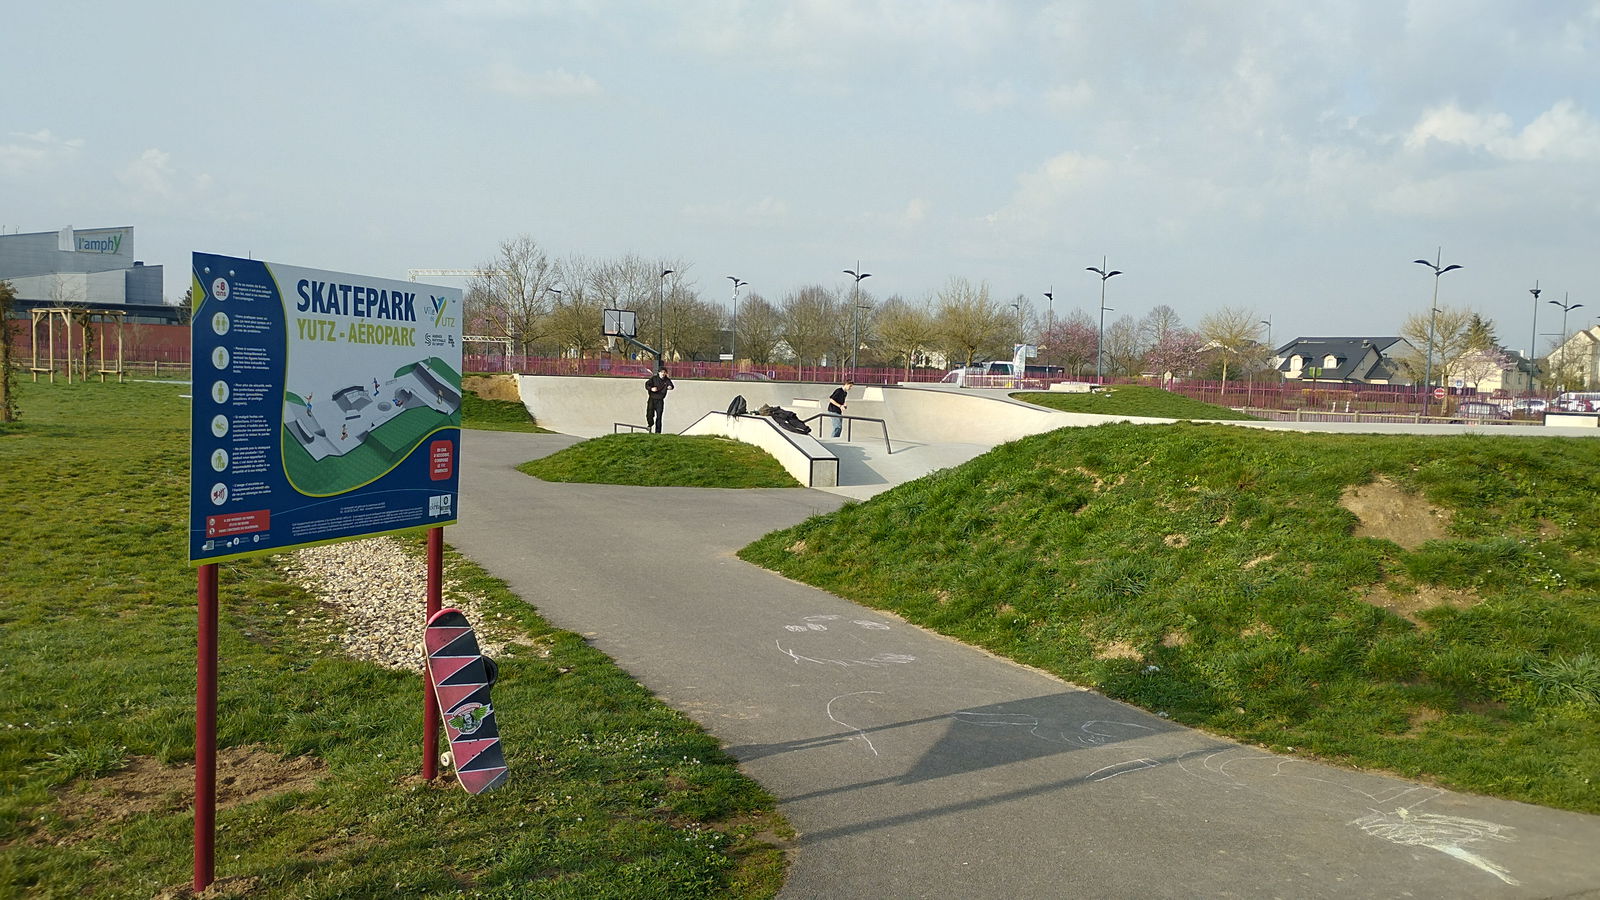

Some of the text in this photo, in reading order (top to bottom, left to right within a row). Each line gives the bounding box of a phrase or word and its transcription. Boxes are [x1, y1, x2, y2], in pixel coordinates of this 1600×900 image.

[78, 233, 122, 254] l'amphy
[297, 279, 416, 322] SKATEPARK
[297, 318, 336, 342] YUTZ
[348, 319, 416, 347] AÉROPARC
